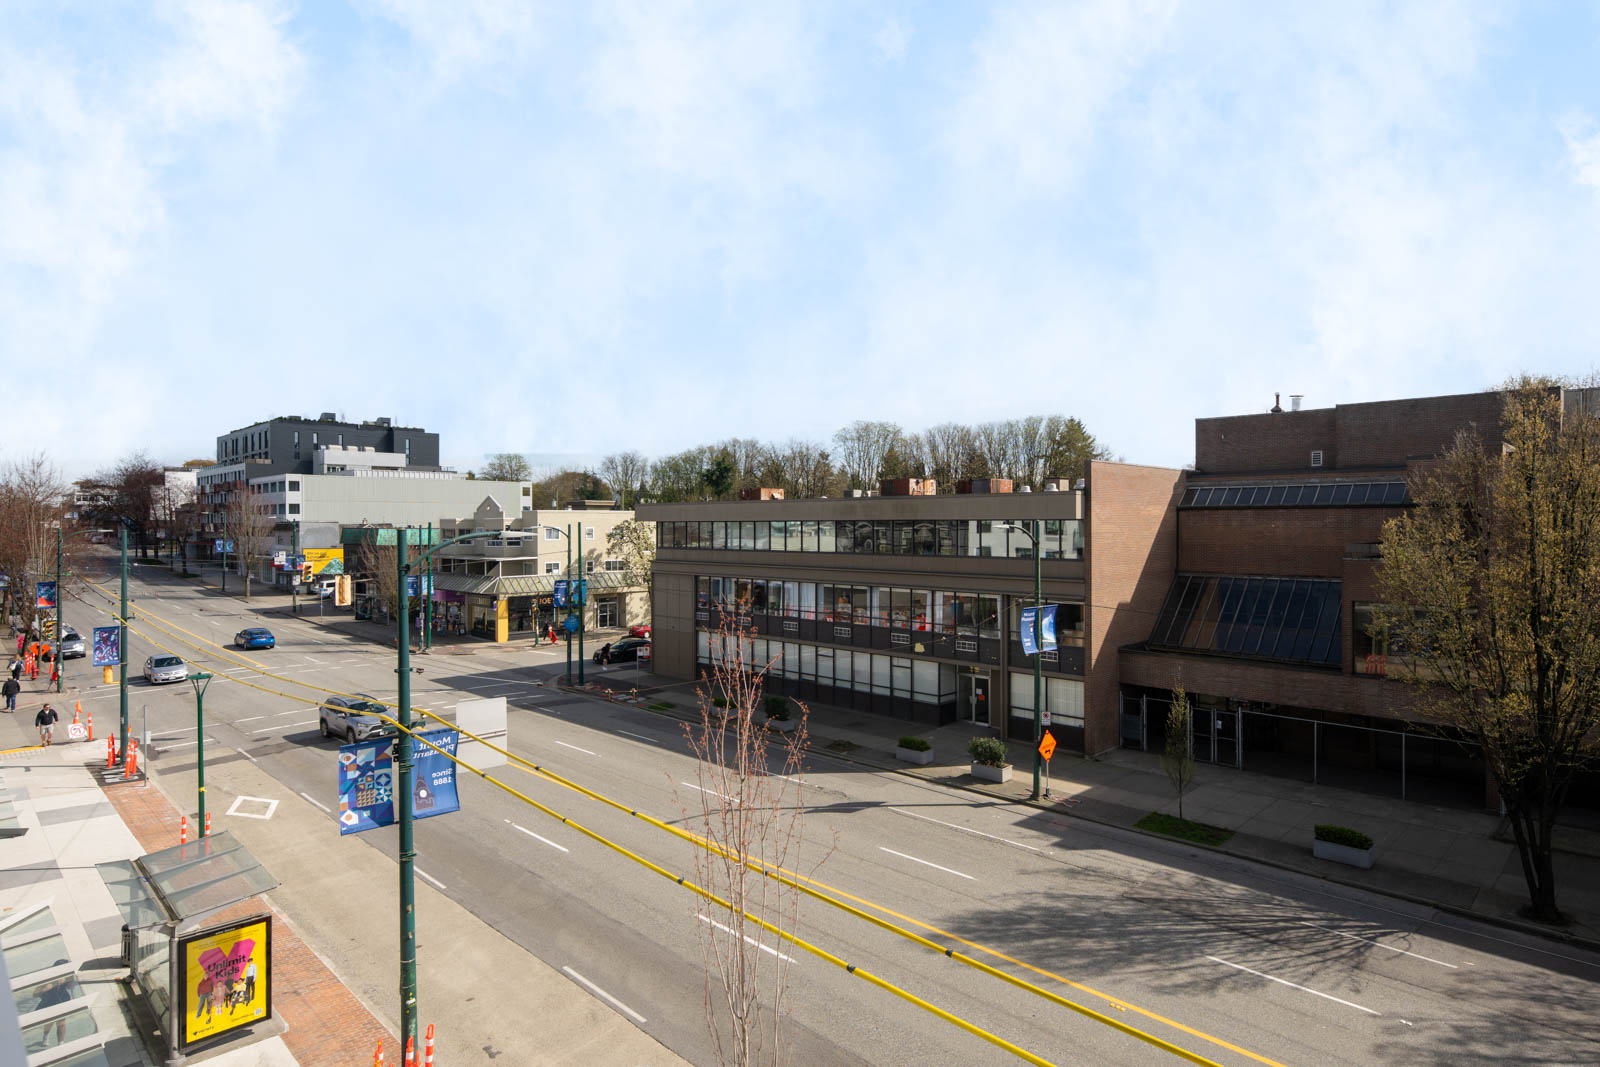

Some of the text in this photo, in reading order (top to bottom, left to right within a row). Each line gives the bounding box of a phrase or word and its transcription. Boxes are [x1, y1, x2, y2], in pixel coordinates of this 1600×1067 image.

[538, 597, 555, 605] JOE'
[208, 955, 246, 972] Unlimit
[215, 965, 241, 979] Kids
